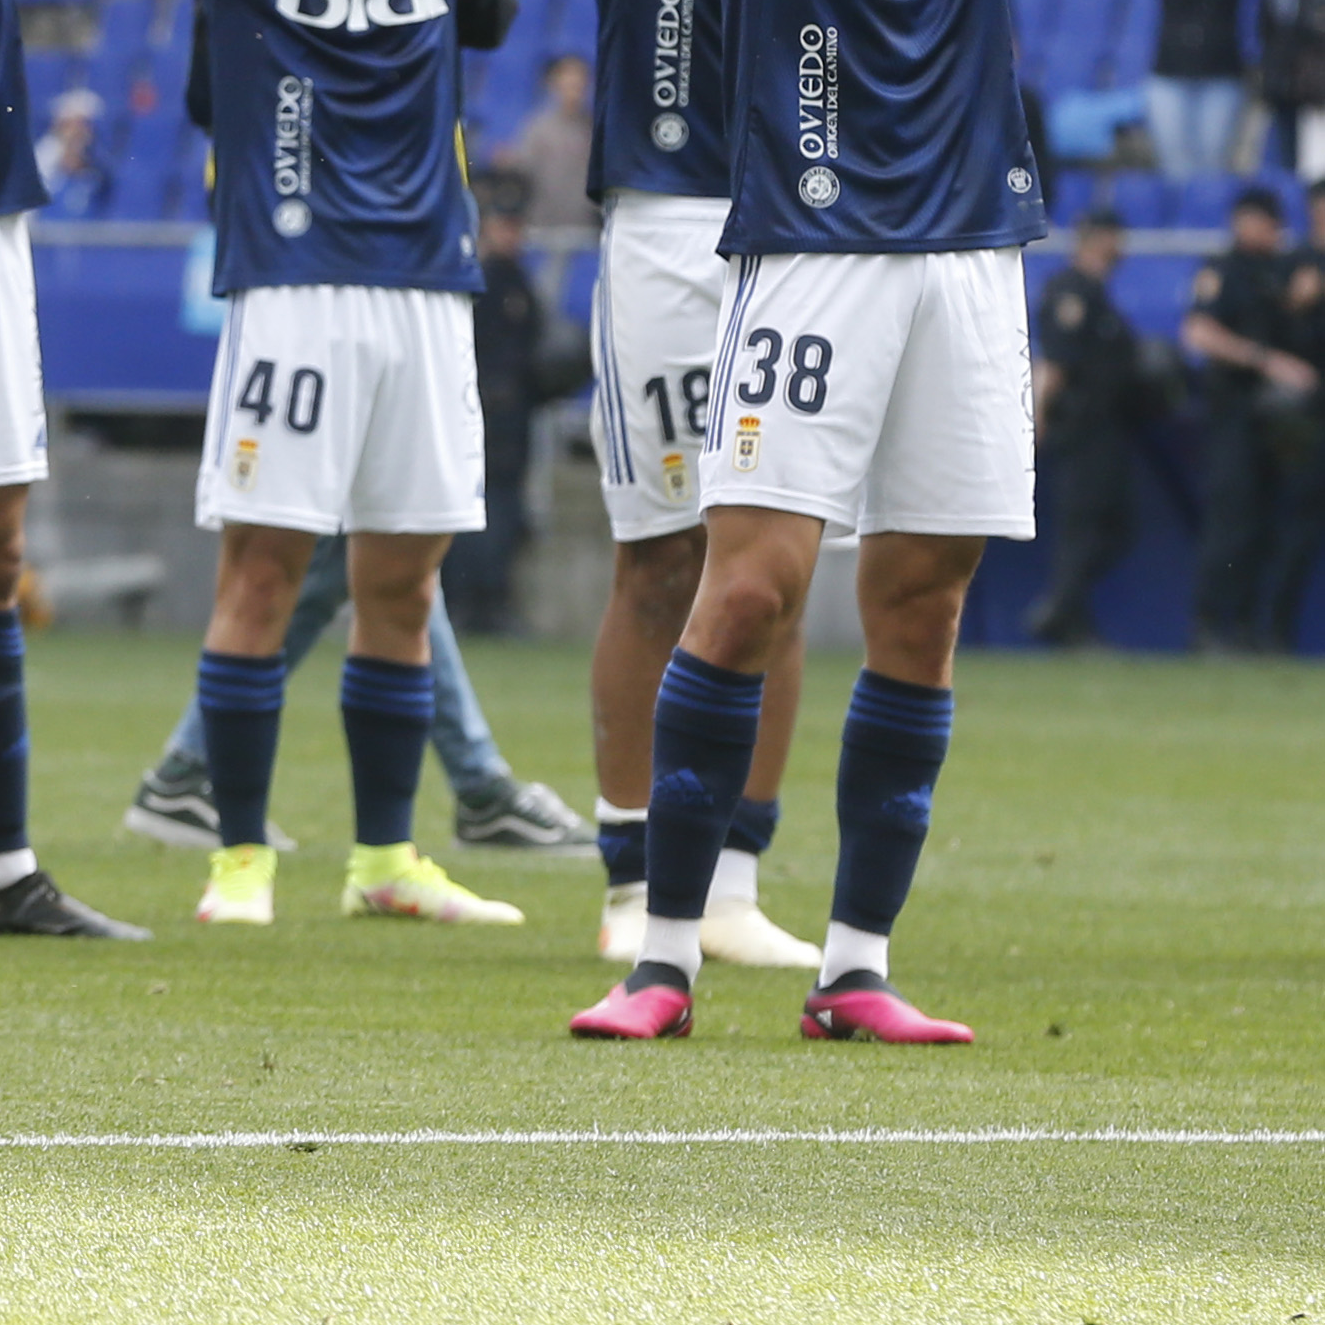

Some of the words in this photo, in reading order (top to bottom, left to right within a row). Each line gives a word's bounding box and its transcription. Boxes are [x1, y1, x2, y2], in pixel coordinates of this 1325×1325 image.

[798, 23, 825, 160] OVIEDO
[826, 26, 838, 83] CAMINO
[826, 84, 838, 110] DEL
[826, 111, 838, 159] ORIGEN
[274, 75, 303, 196] OVIEDO
[235, 359, 325, 435] 40
[644, 368, 711, 444] 18
[734, 327, 833, 416] 38
